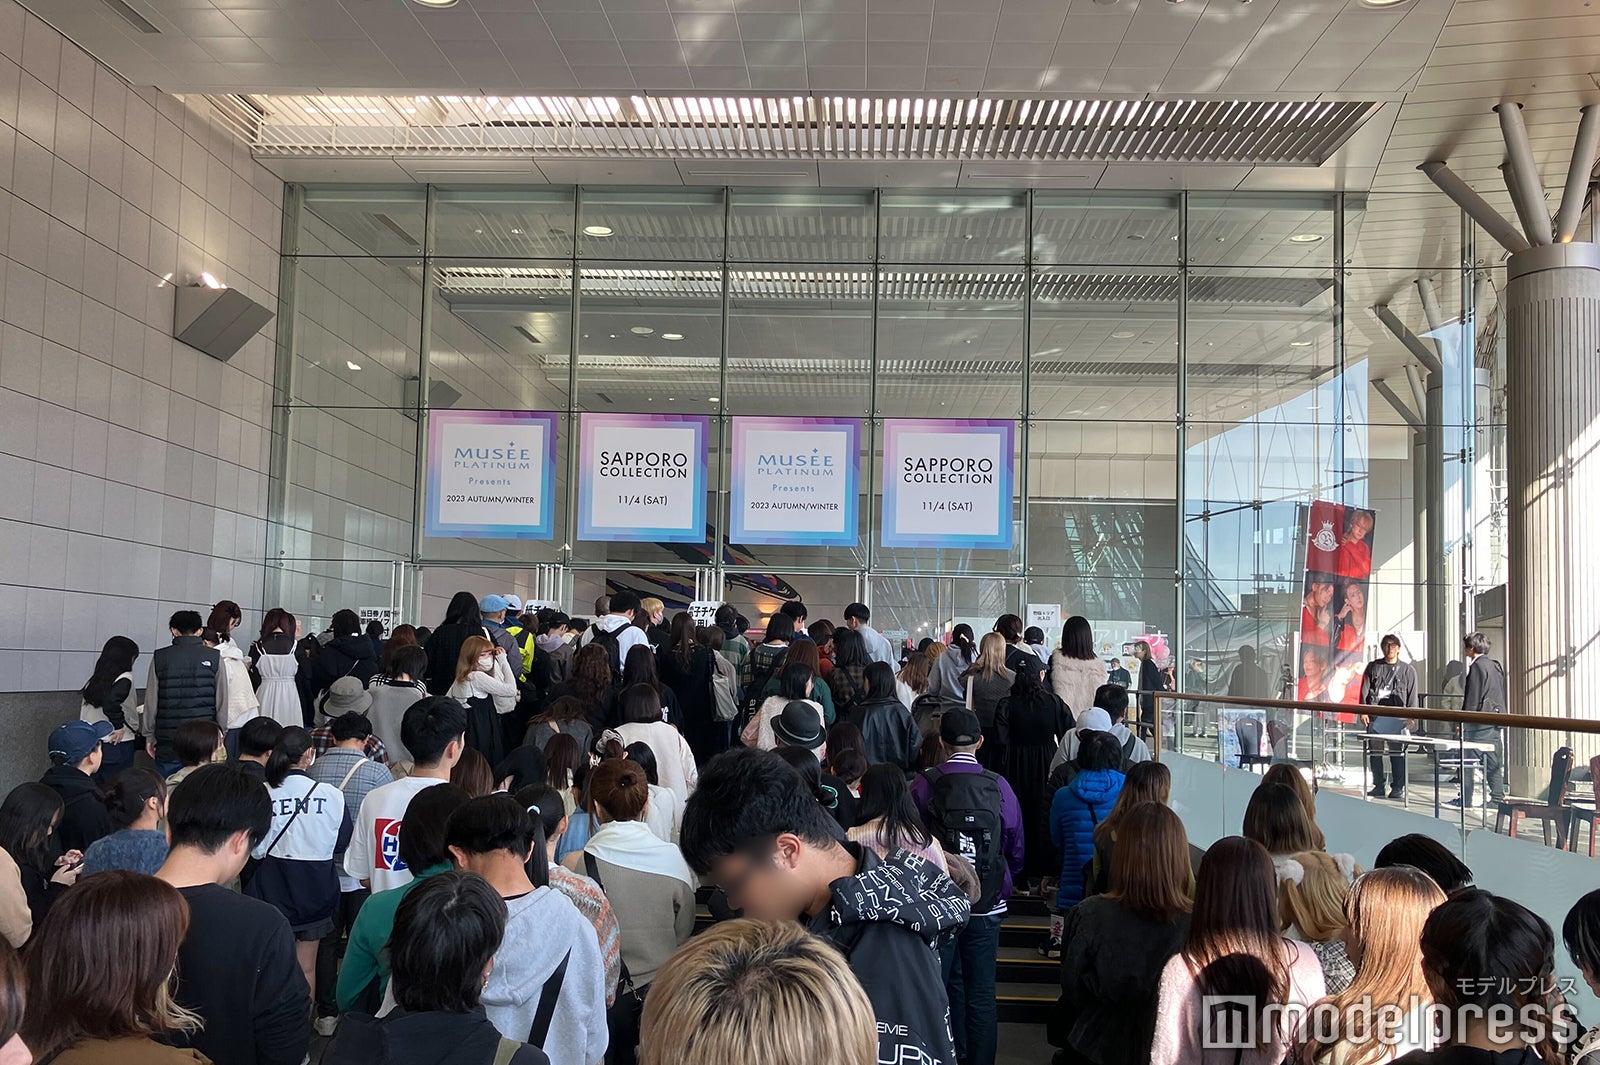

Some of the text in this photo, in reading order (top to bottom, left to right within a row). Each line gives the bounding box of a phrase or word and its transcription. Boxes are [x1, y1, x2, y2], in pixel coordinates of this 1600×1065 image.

[600, 451, 688, 467] SAPPORO
[454, 461, 530, 470] PLATINUM
[904, 457, 993, 473] SAPPORO
[600, 466, 687, 479] COLLECTION
[757, 468, 834, 476] PLATINUM
[468, 476, 511, 486] Presents
[903, 472, 993, 484] COLLECTION
[772, 483, 815, 493] Presents
[446, 494, 535, 504] 2023 AUTUMN/WINTER
[618, 494, 668, 506] 11/4 (SAT)
[750, 501, 839, 511] 2023 AUTUMN/WINTER
[922, 500, 973, 512] 11/4 (SAT)
